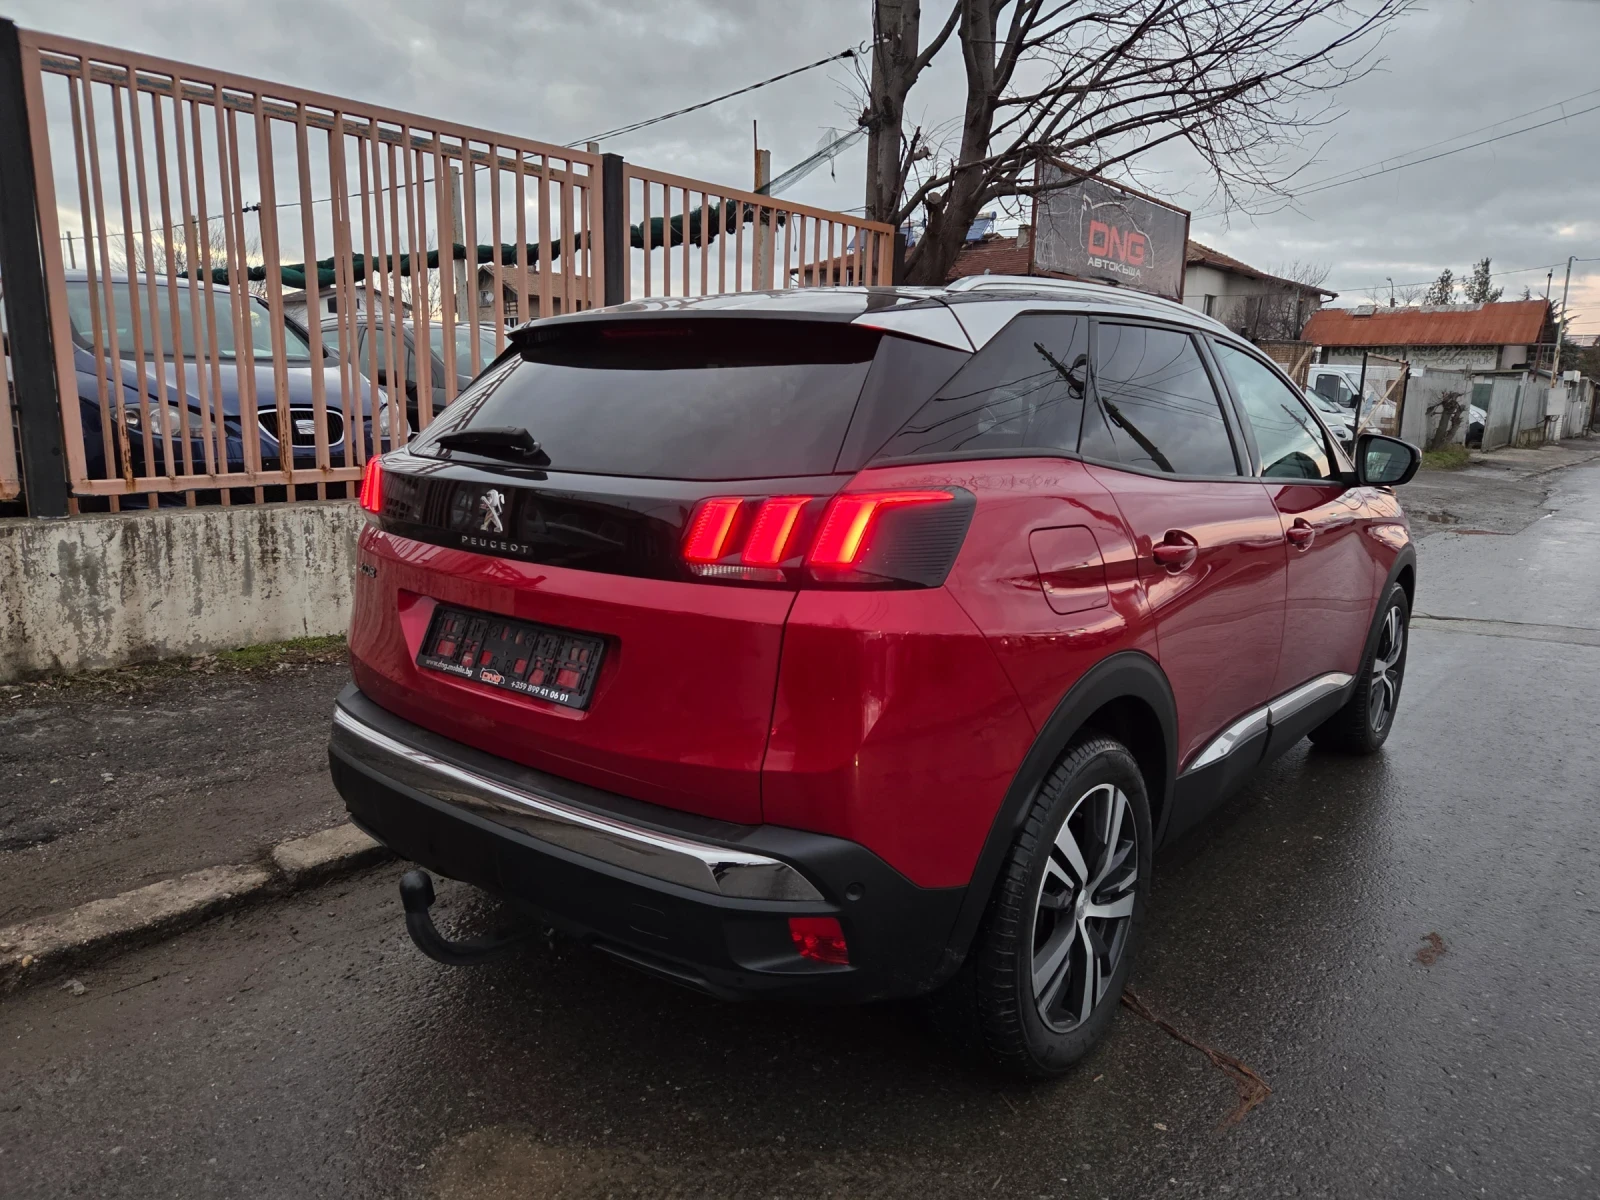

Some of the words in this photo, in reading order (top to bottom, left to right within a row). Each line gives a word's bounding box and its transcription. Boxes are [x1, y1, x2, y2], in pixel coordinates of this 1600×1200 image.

[1088, 219, 1146, 266] DNG
[461, 535, 529, 554] PEUGEOT
[425, 659, 473, 678] www.dng.mobile.bg
[482, 671, 502, 683] DNG
[510, 680, 528, 691] +359
[527, 684, 540, 694] 899
[540, 688, 549, 697] 41
[549, 691, 559, 699] 06
[559, 693, 569, 702] 01
